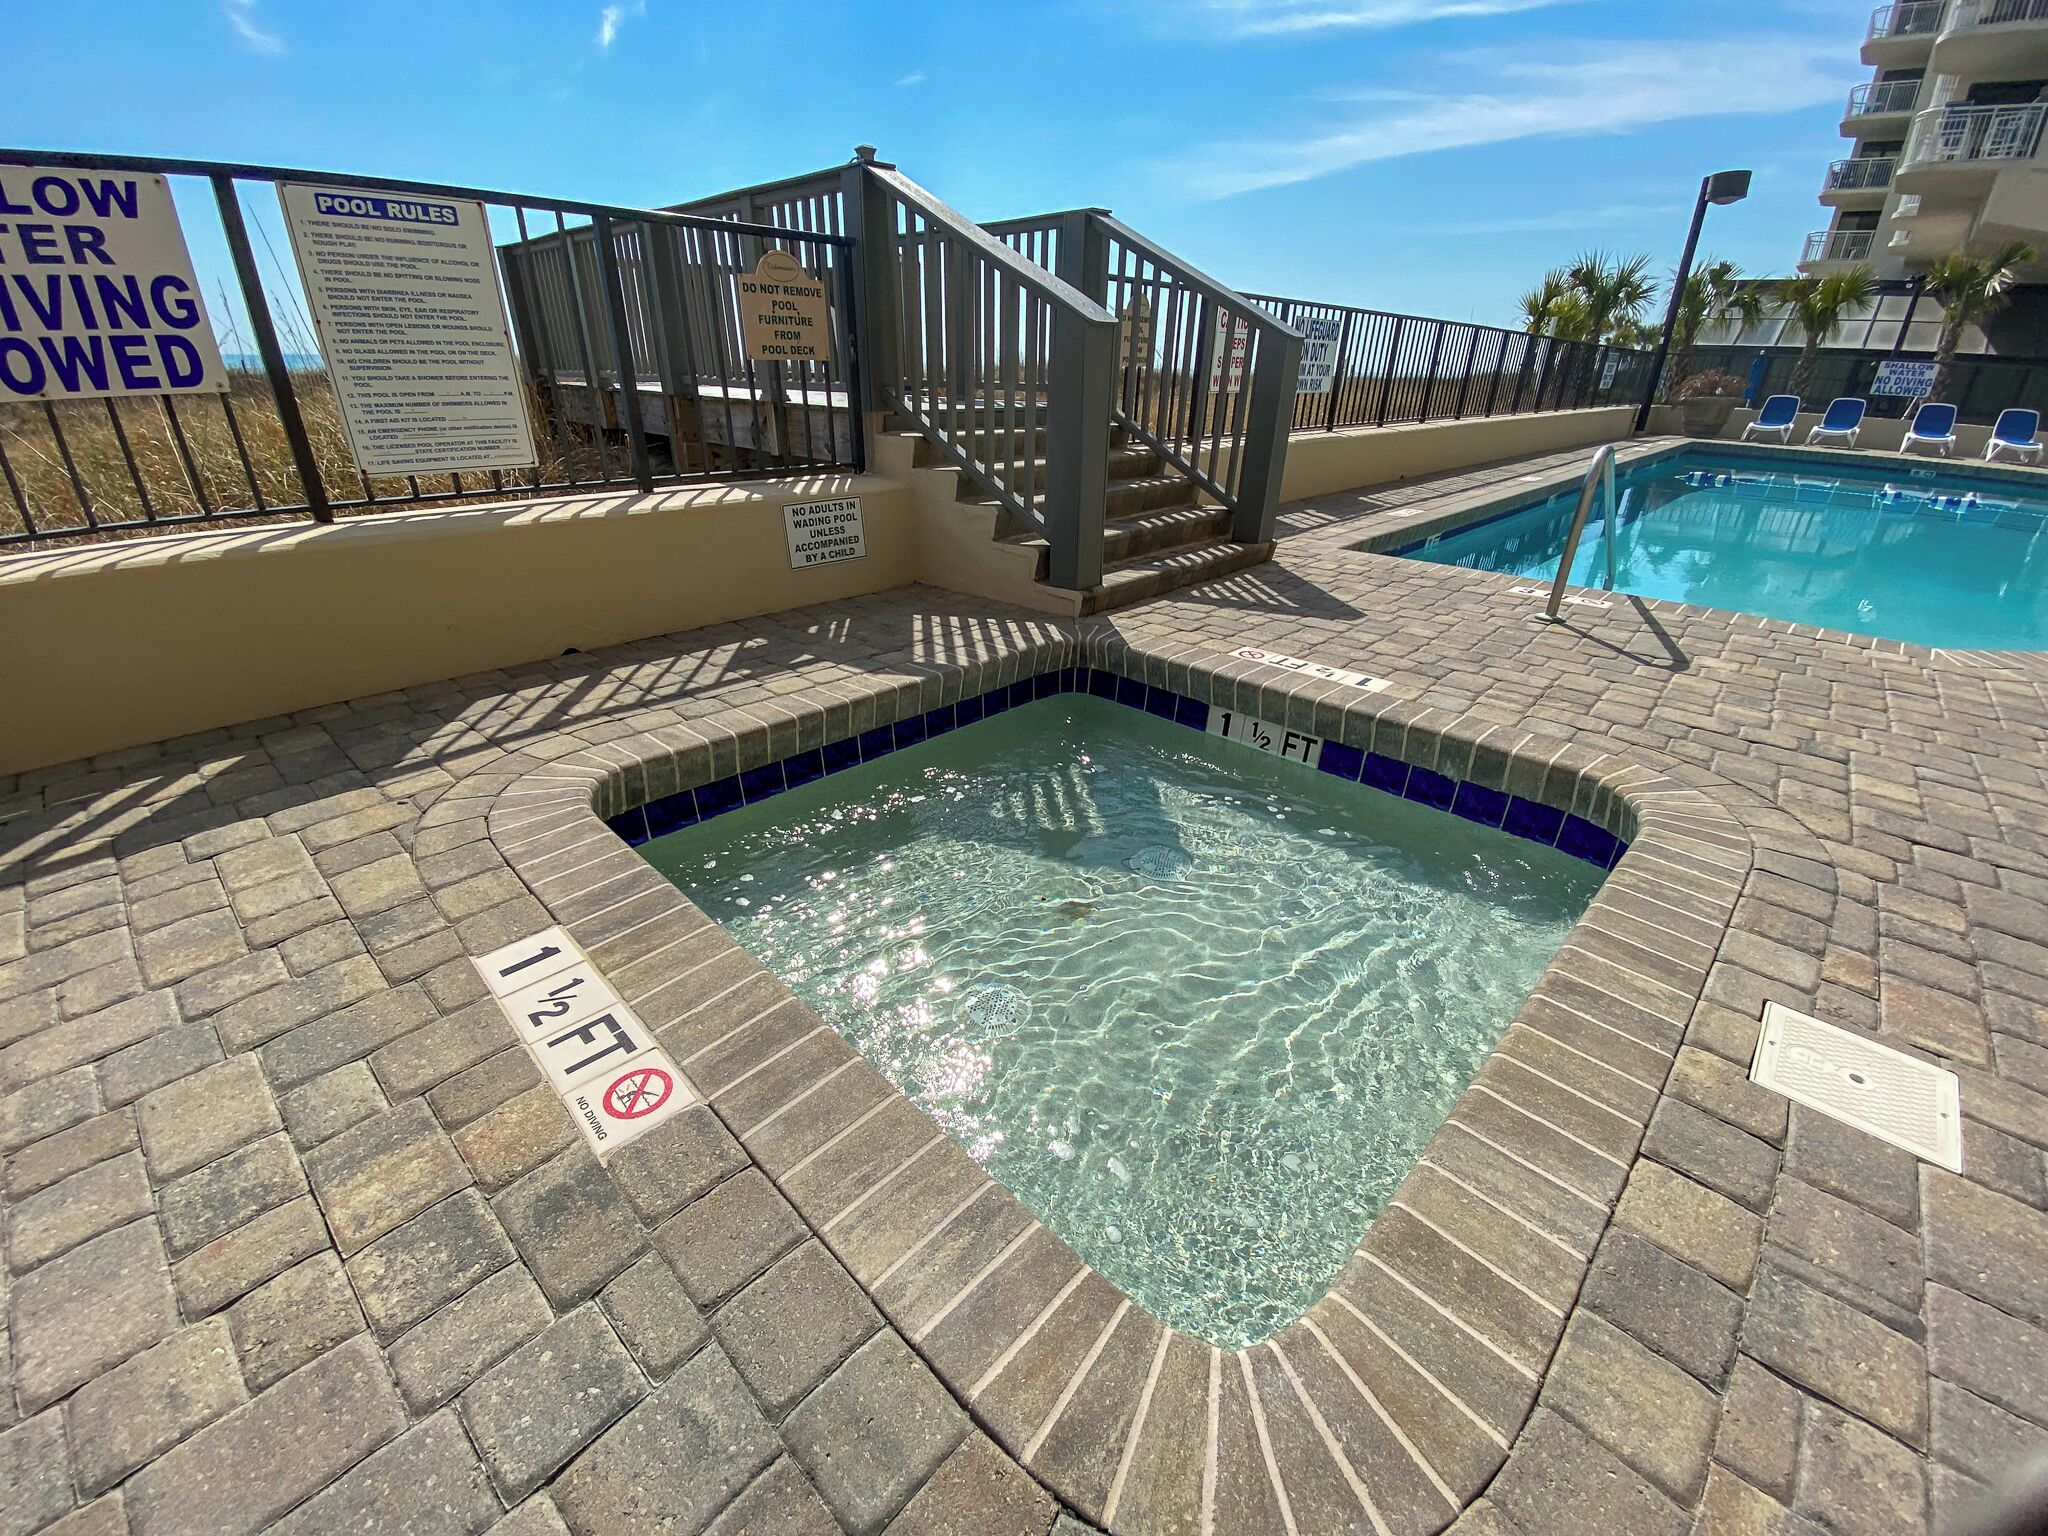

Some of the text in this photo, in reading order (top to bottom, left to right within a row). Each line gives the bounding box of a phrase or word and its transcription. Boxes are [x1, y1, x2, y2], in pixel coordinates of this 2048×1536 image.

[0, 176, 139, 219] LOW
[318, 197, 455, 223] POOL RULES
[742, 282, 822, 298] DO NOT REMOVE
[772, 300, 798, 312] POOL
[758, 314, 813, 327] FURNITURE
[774, 330, 801, 341] FROM
[762, 345, 815, 356] POOL DECK
[0, 334, 204, 395] OWED
[1884, 362, 1935, 371] SHALLOW
[1874, 375, 1933, 387] NO DIVING
[1888, 369, 1925, 377] WATER
[1873, 385, 1927, 396] ALLOWED
[792, 501, 856, 517] NO ADULTS IN
[793, 512, 858, 529] WADING POOL
[809, 526, 846, 538] UNLESS
[795, 535, 860, 553] ACCOMPANIED
[805, 547, 856, 563] BY A CHILD
[1221, 712, 1232, 737] 1
[1281, 730, 1318, 763] FT
[546, 1013, 638, 1075] FT
[575, 1096, 608, 1141] NO DIVING
